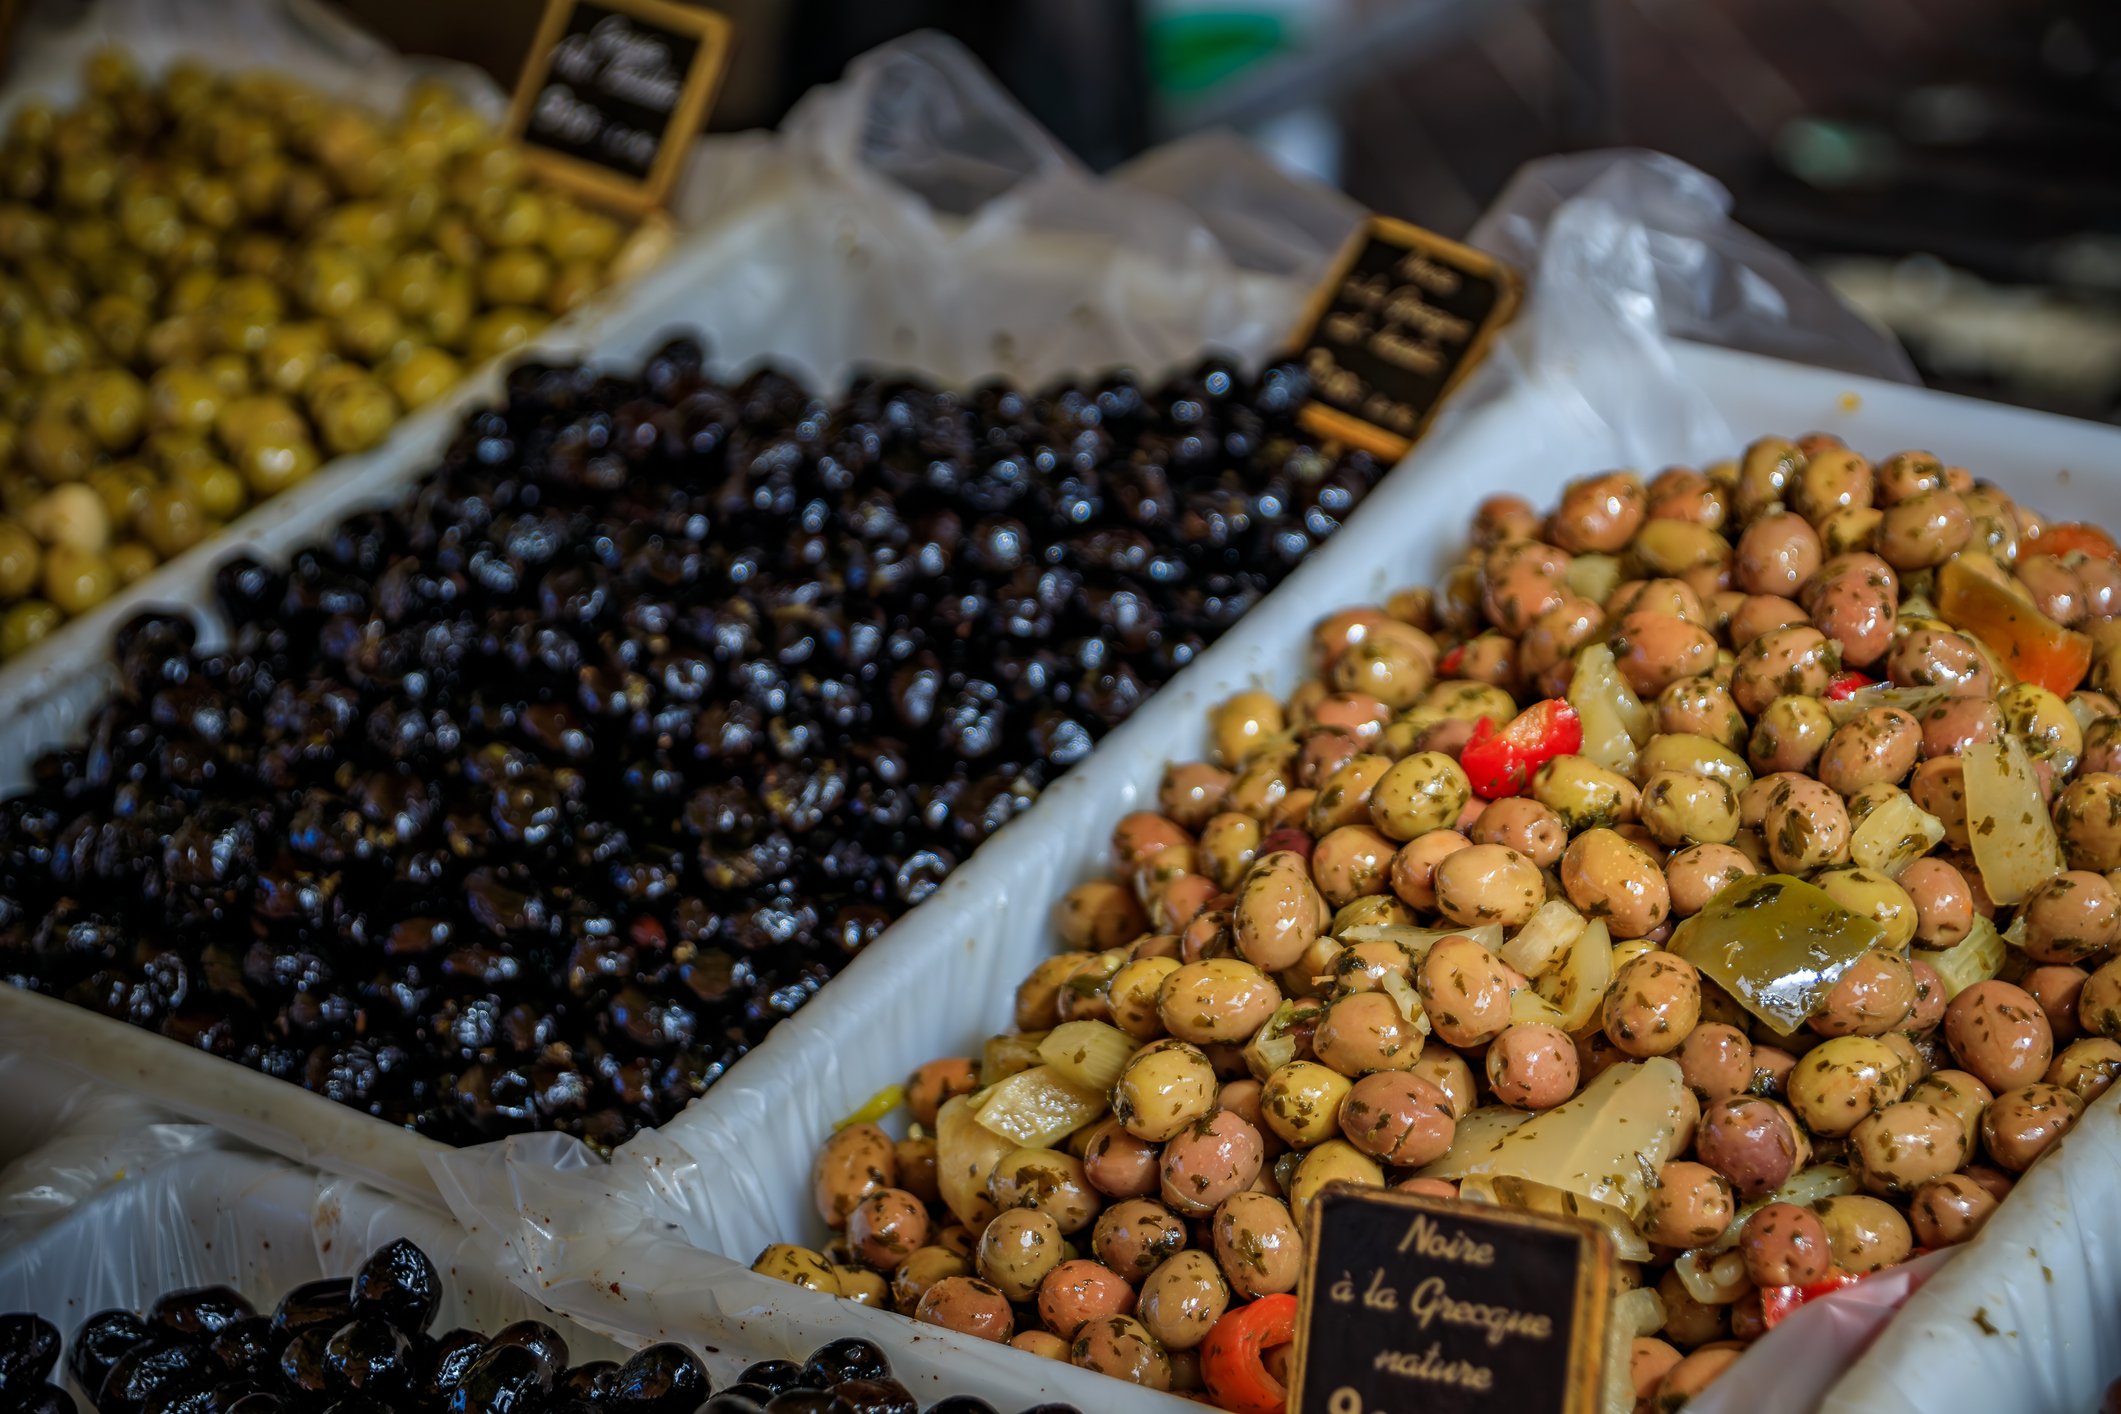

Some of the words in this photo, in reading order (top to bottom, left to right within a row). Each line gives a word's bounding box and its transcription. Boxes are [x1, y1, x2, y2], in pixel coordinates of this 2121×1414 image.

[1398, 1214, 1494, 1266] Noire
[1330, 1269, 1355, 1303] à
[1364, 1267, 1398, 1310] la
[1411, 1276, 1552, 1346] Grecque
[1374, 1342, 1492, 1390] nature
